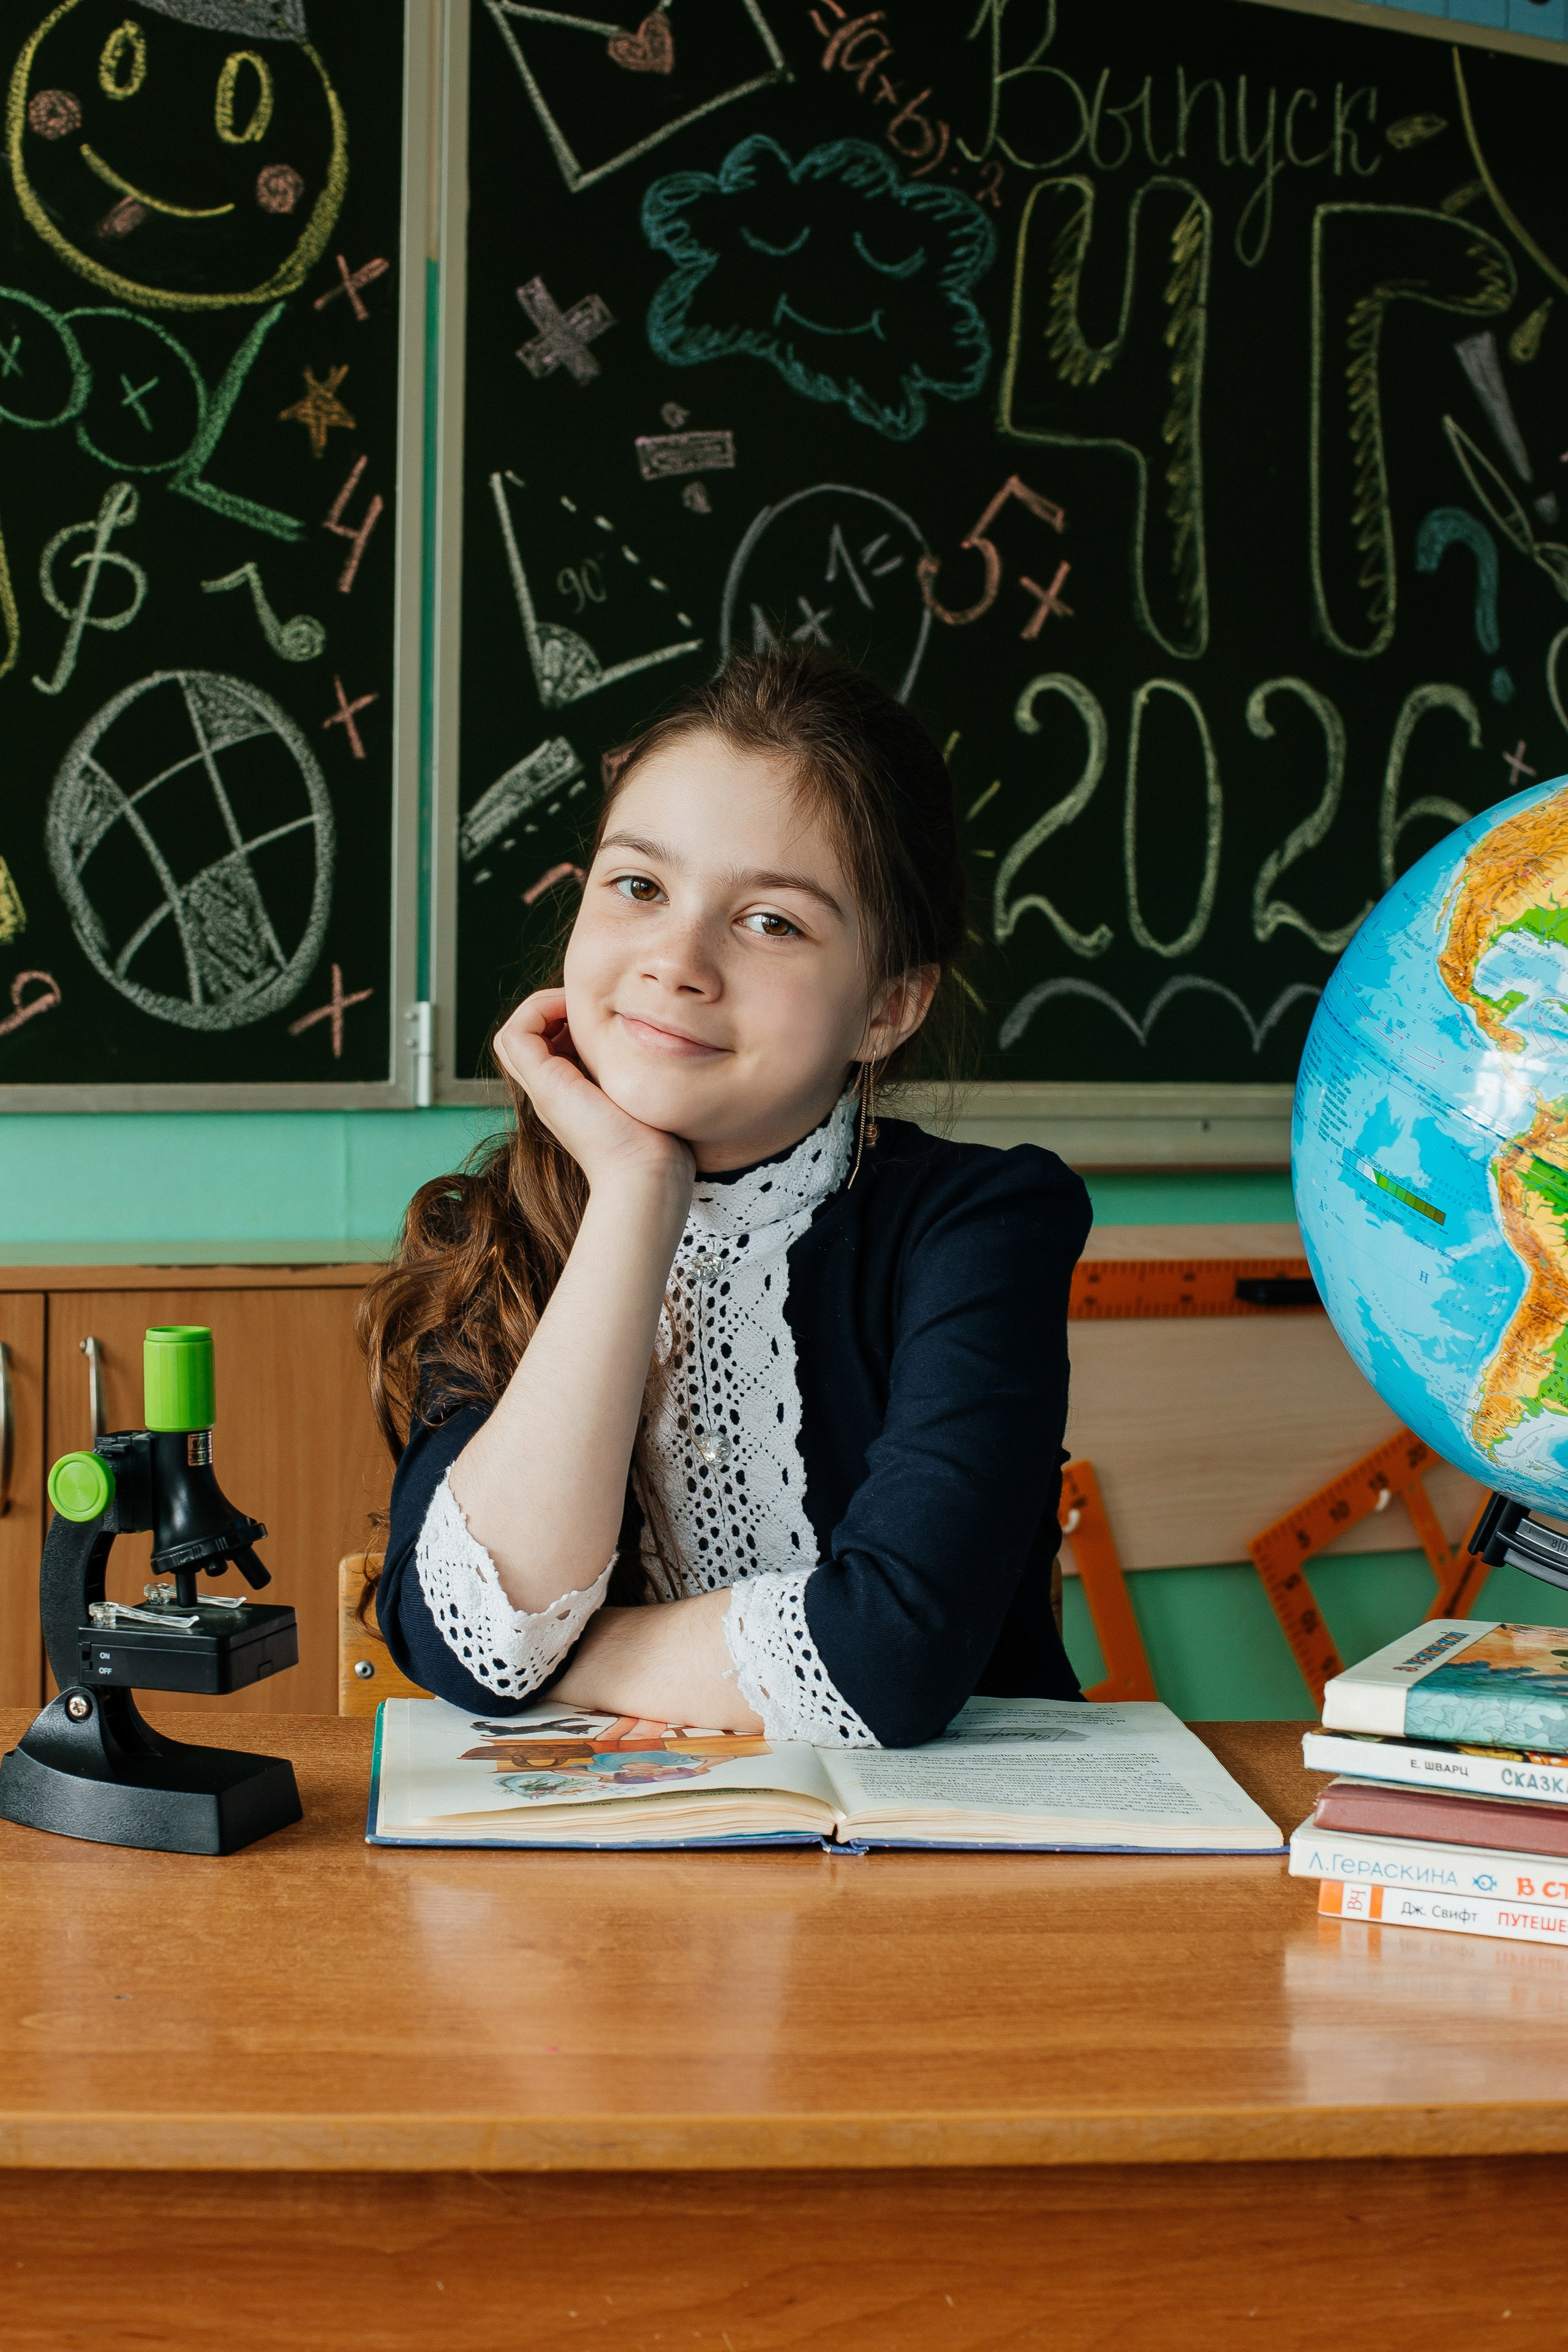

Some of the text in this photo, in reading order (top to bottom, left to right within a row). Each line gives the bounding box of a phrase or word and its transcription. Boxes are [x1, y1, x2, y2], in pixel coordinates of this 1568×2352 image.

[957, 0, 1382, 266] Выпуск
[993, 671, 1483, 957] 2026
[1500, 1357, 1539, 1379] Сантьяго
[1410, 1759, 1568, 1793] Е. ШВАРЦ СКАЗК
[1517, 1877, 1535, 1896] В
[1401, 1901, 1567, 1932] Дж. Свифт ПУТЕШЕ
